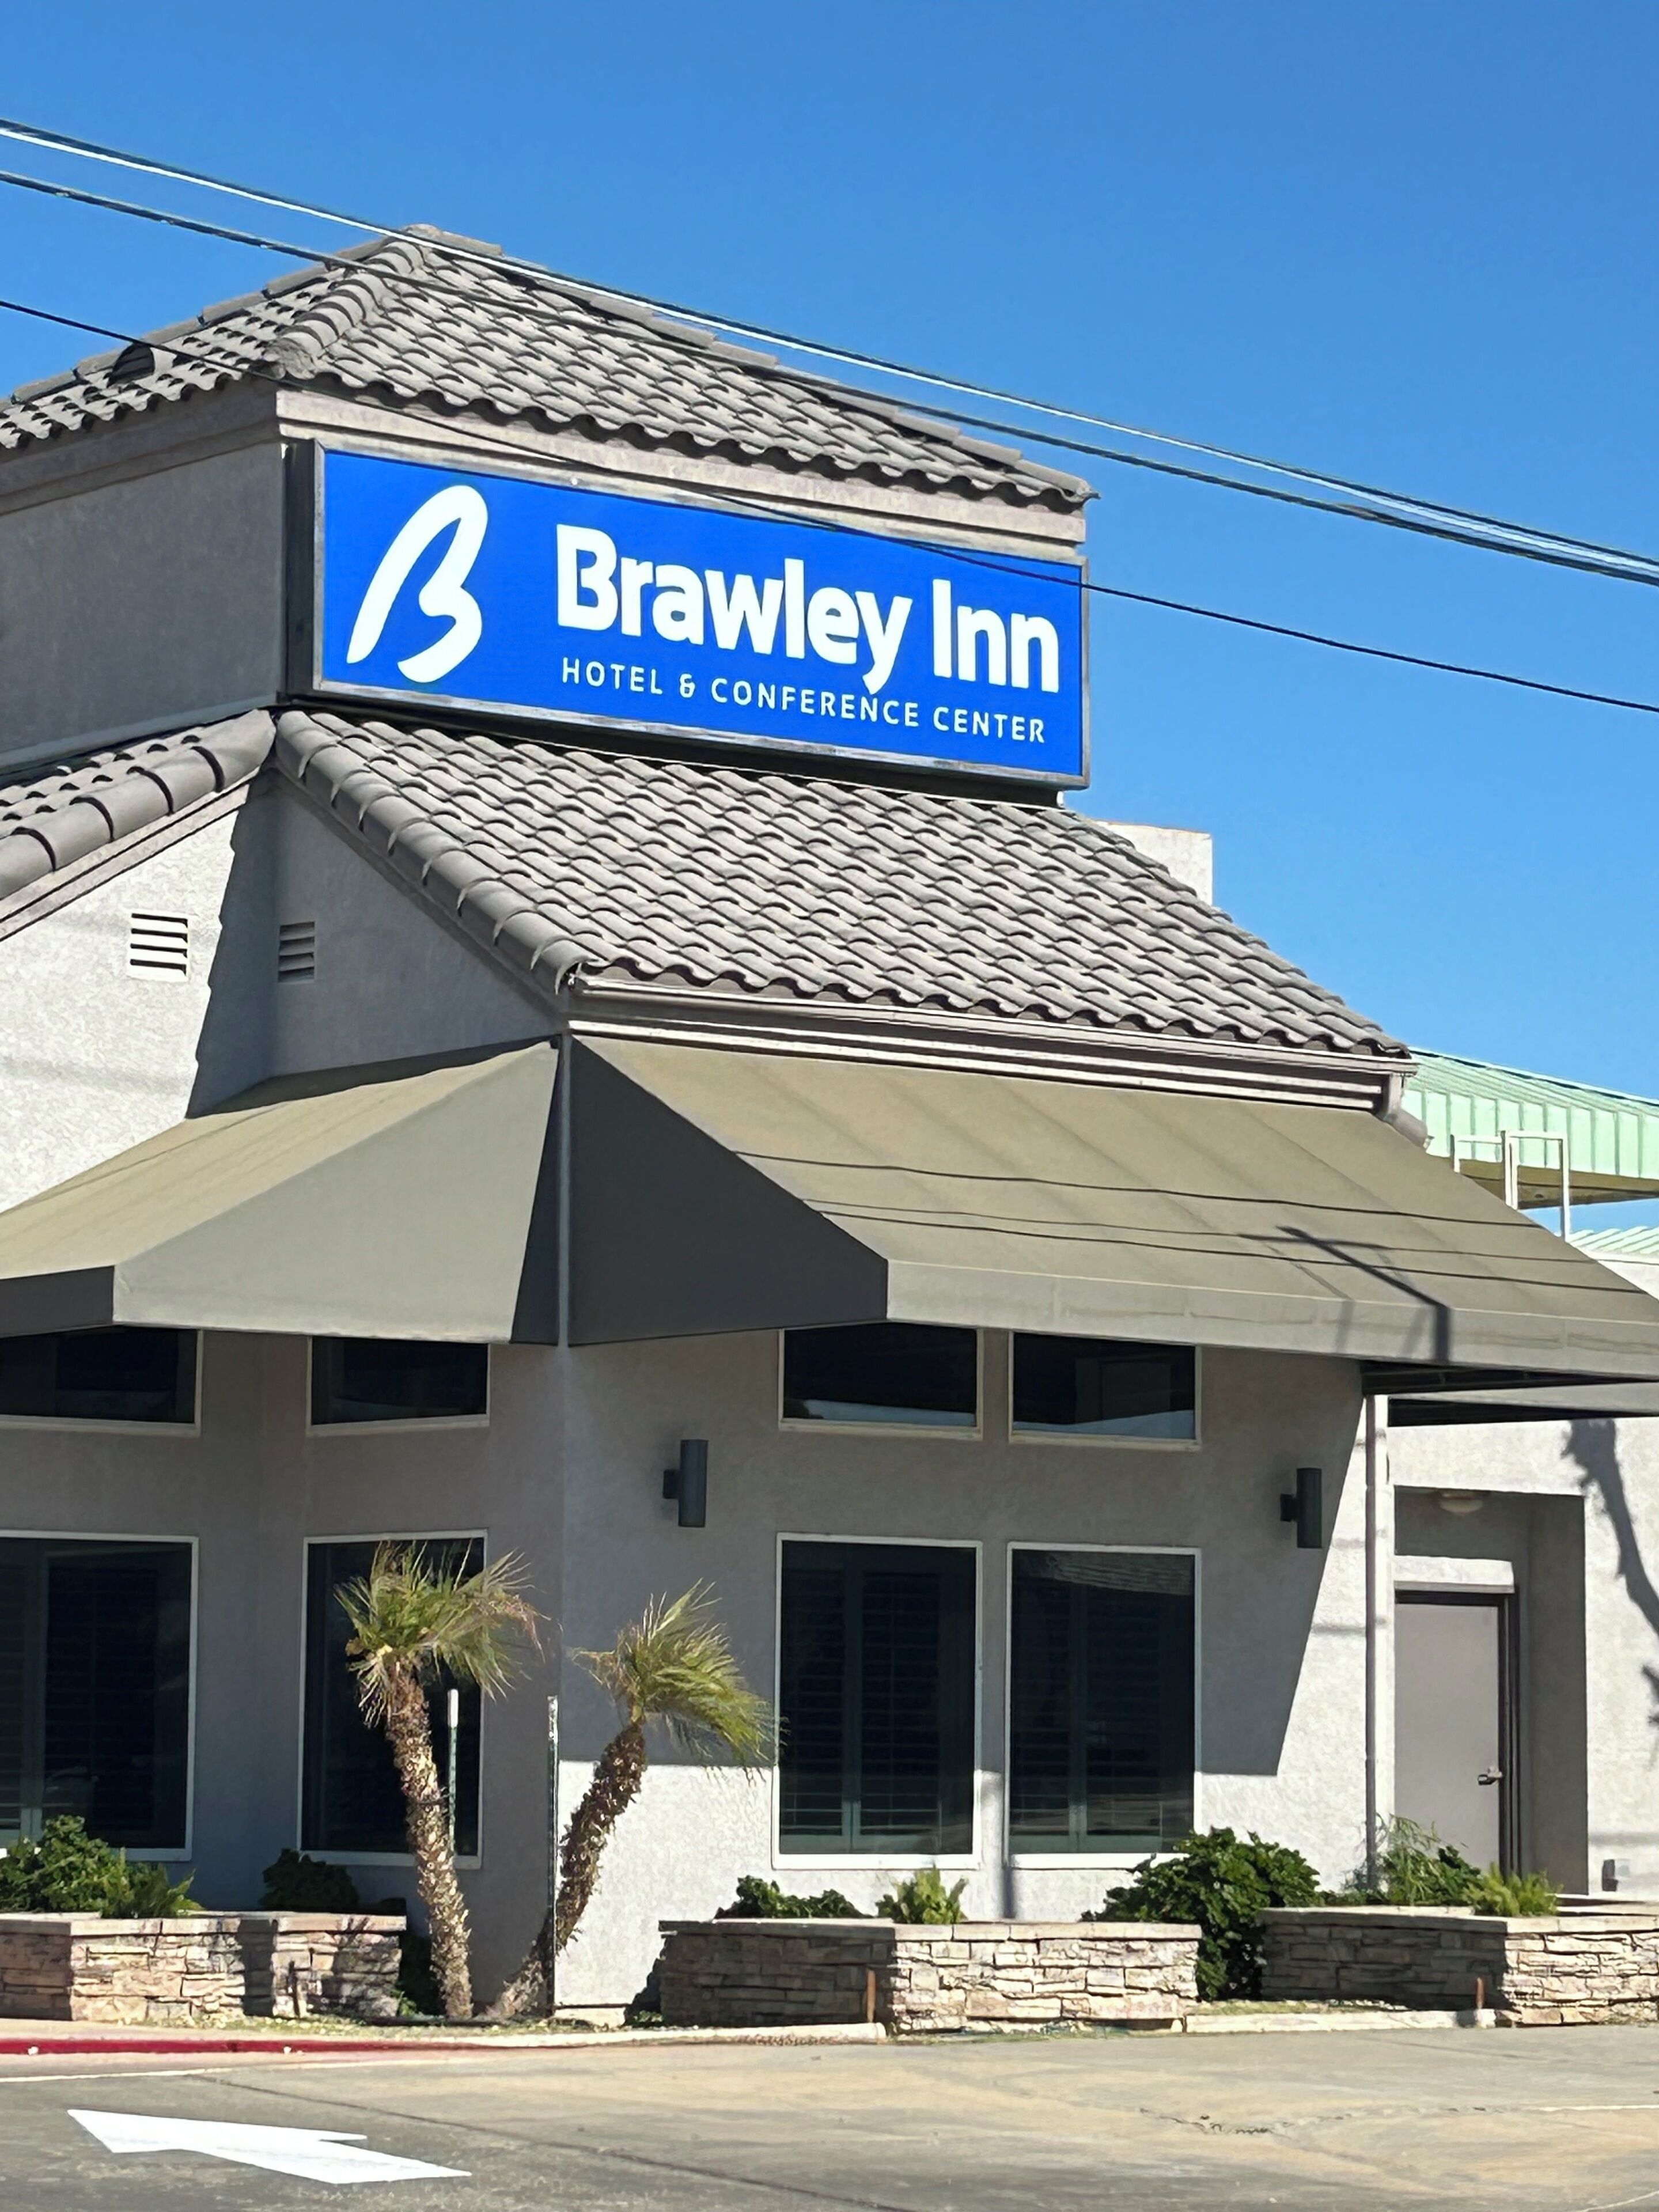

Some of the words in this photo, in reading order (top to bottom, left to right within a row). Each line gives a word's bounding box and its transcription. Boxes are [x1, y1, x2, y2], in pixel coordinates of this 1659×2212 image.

[556, 524, 912, 695] Brawley
[933, 579, 1059, 692] Inn
[563, 658, 662, 695] HOTEL
[680, 674, 695, 698] &
[711, 678, 918, 726] CONFERENCE
[934, 707, 1044, 743] CENTER
